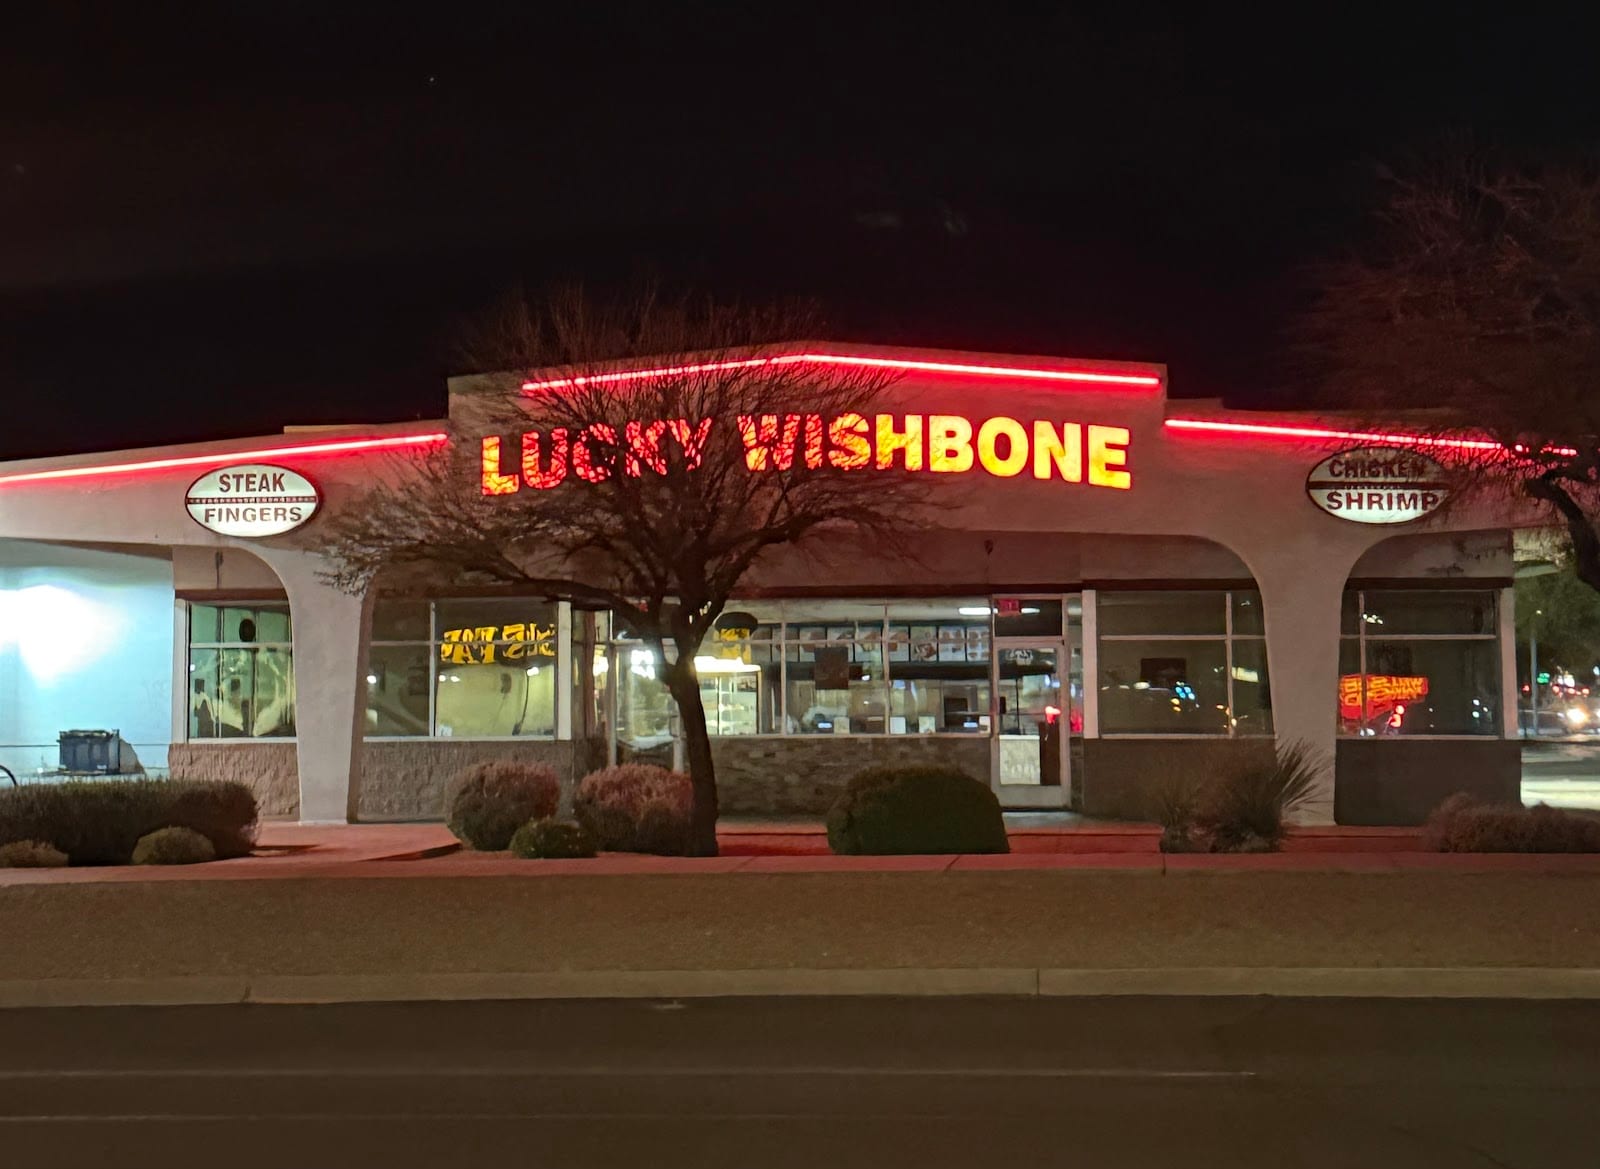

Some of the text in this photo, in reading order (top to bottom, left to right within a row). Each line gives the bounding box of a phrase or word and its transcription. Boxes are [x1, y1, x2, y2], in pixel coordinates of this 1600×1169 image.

[481, 413, 1131, 496] LUCKY WISHBONE
[219, 472, 286, 493] STEAK
[1326, 490, 1440, 512] SHRIMP
[203, 506, 303, 524] FINGERS
